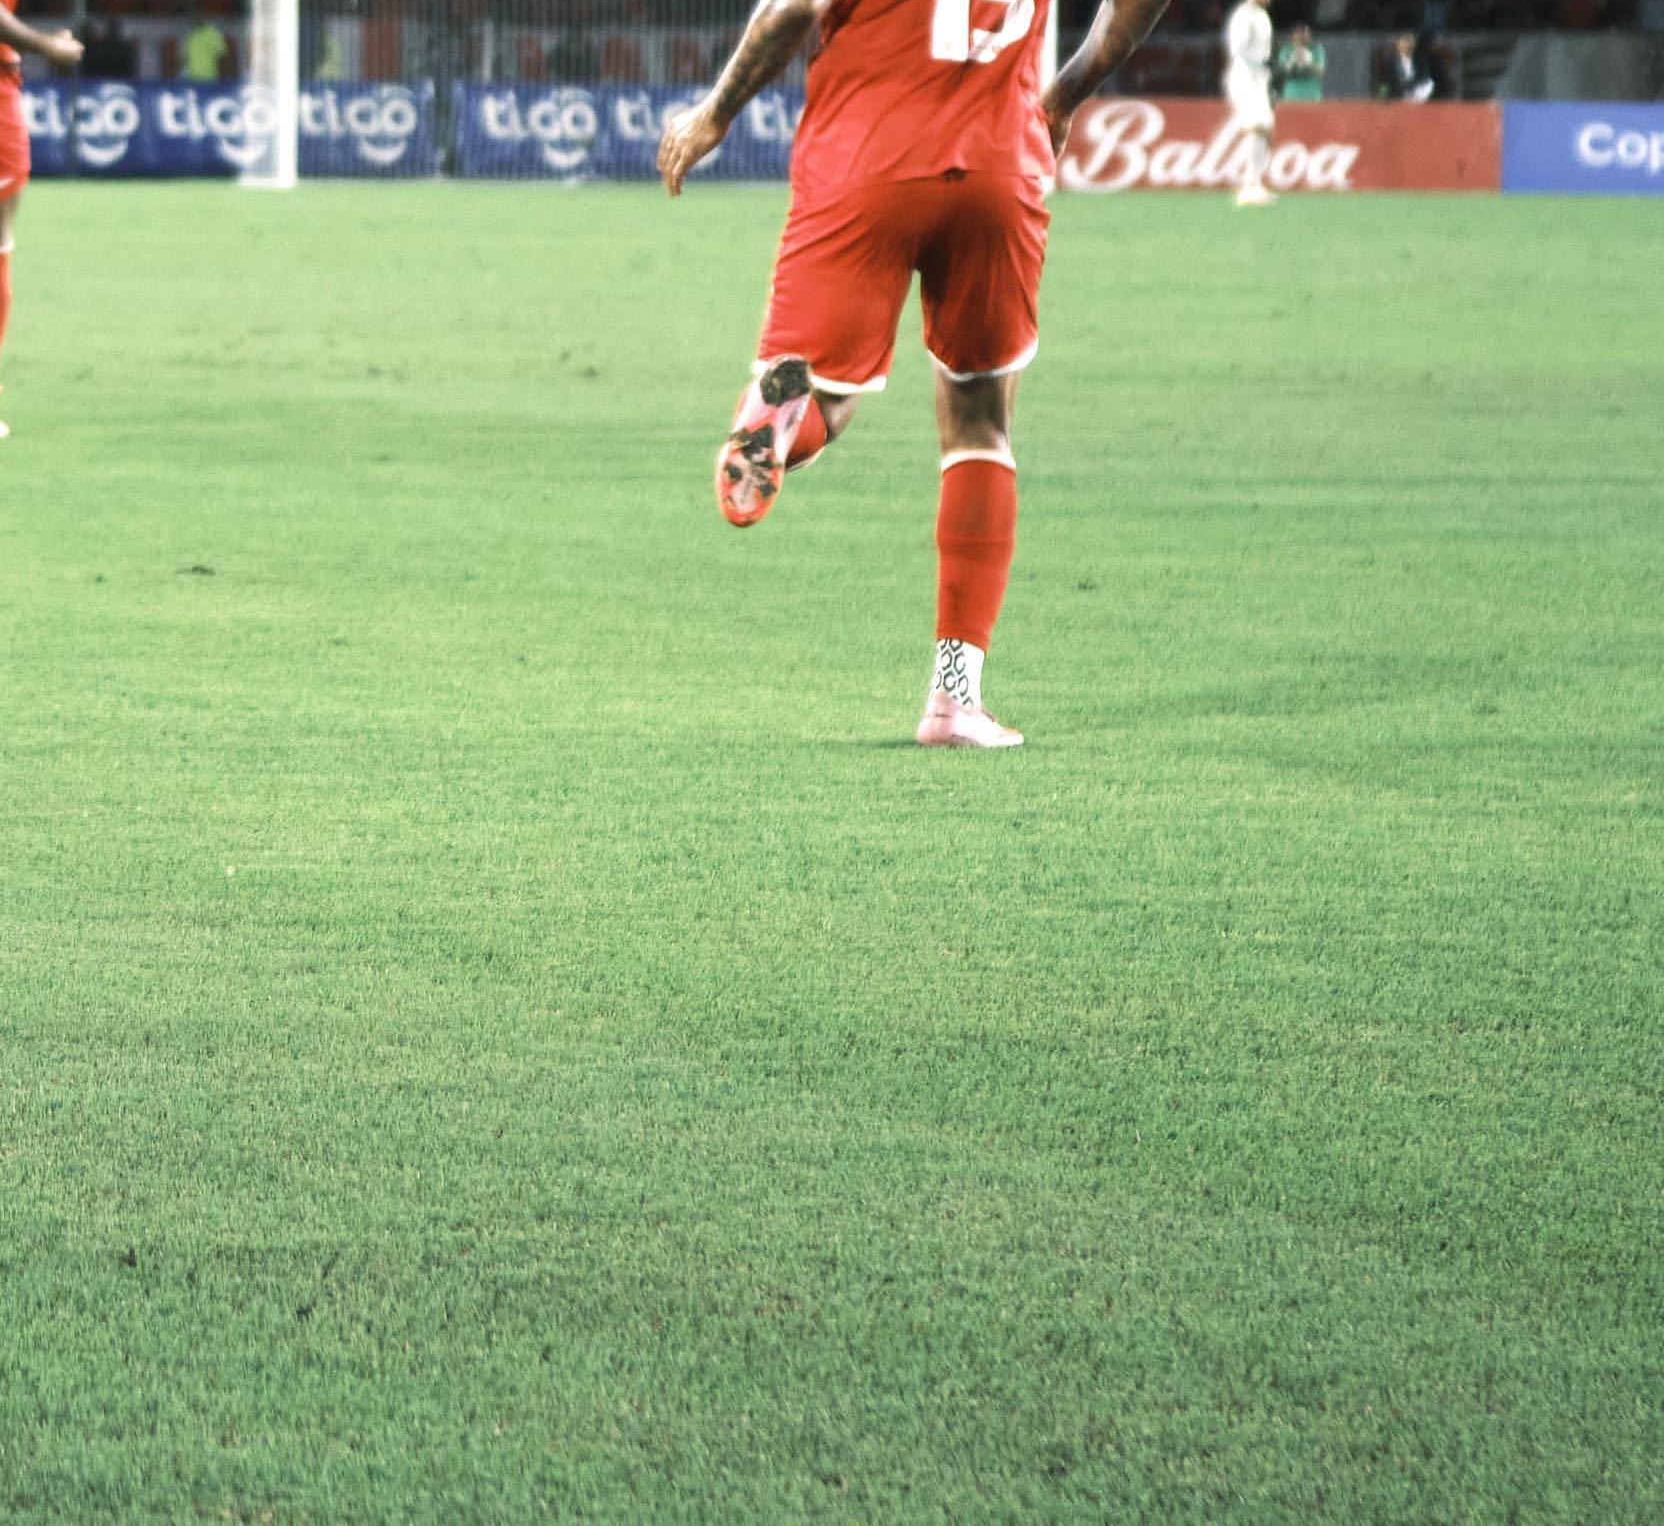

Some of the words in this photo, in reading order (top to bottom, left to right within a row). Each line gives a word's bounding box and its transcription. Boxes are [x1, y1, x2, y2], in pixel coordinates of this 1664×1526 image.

[24, 86, 139, 164] tigo
[159, 86, 276, 164] tigo
[300, 86, 417, 164] tigo
[481, 86, 598, 167] tigo
[1578, 123, 1664, 171] Co
